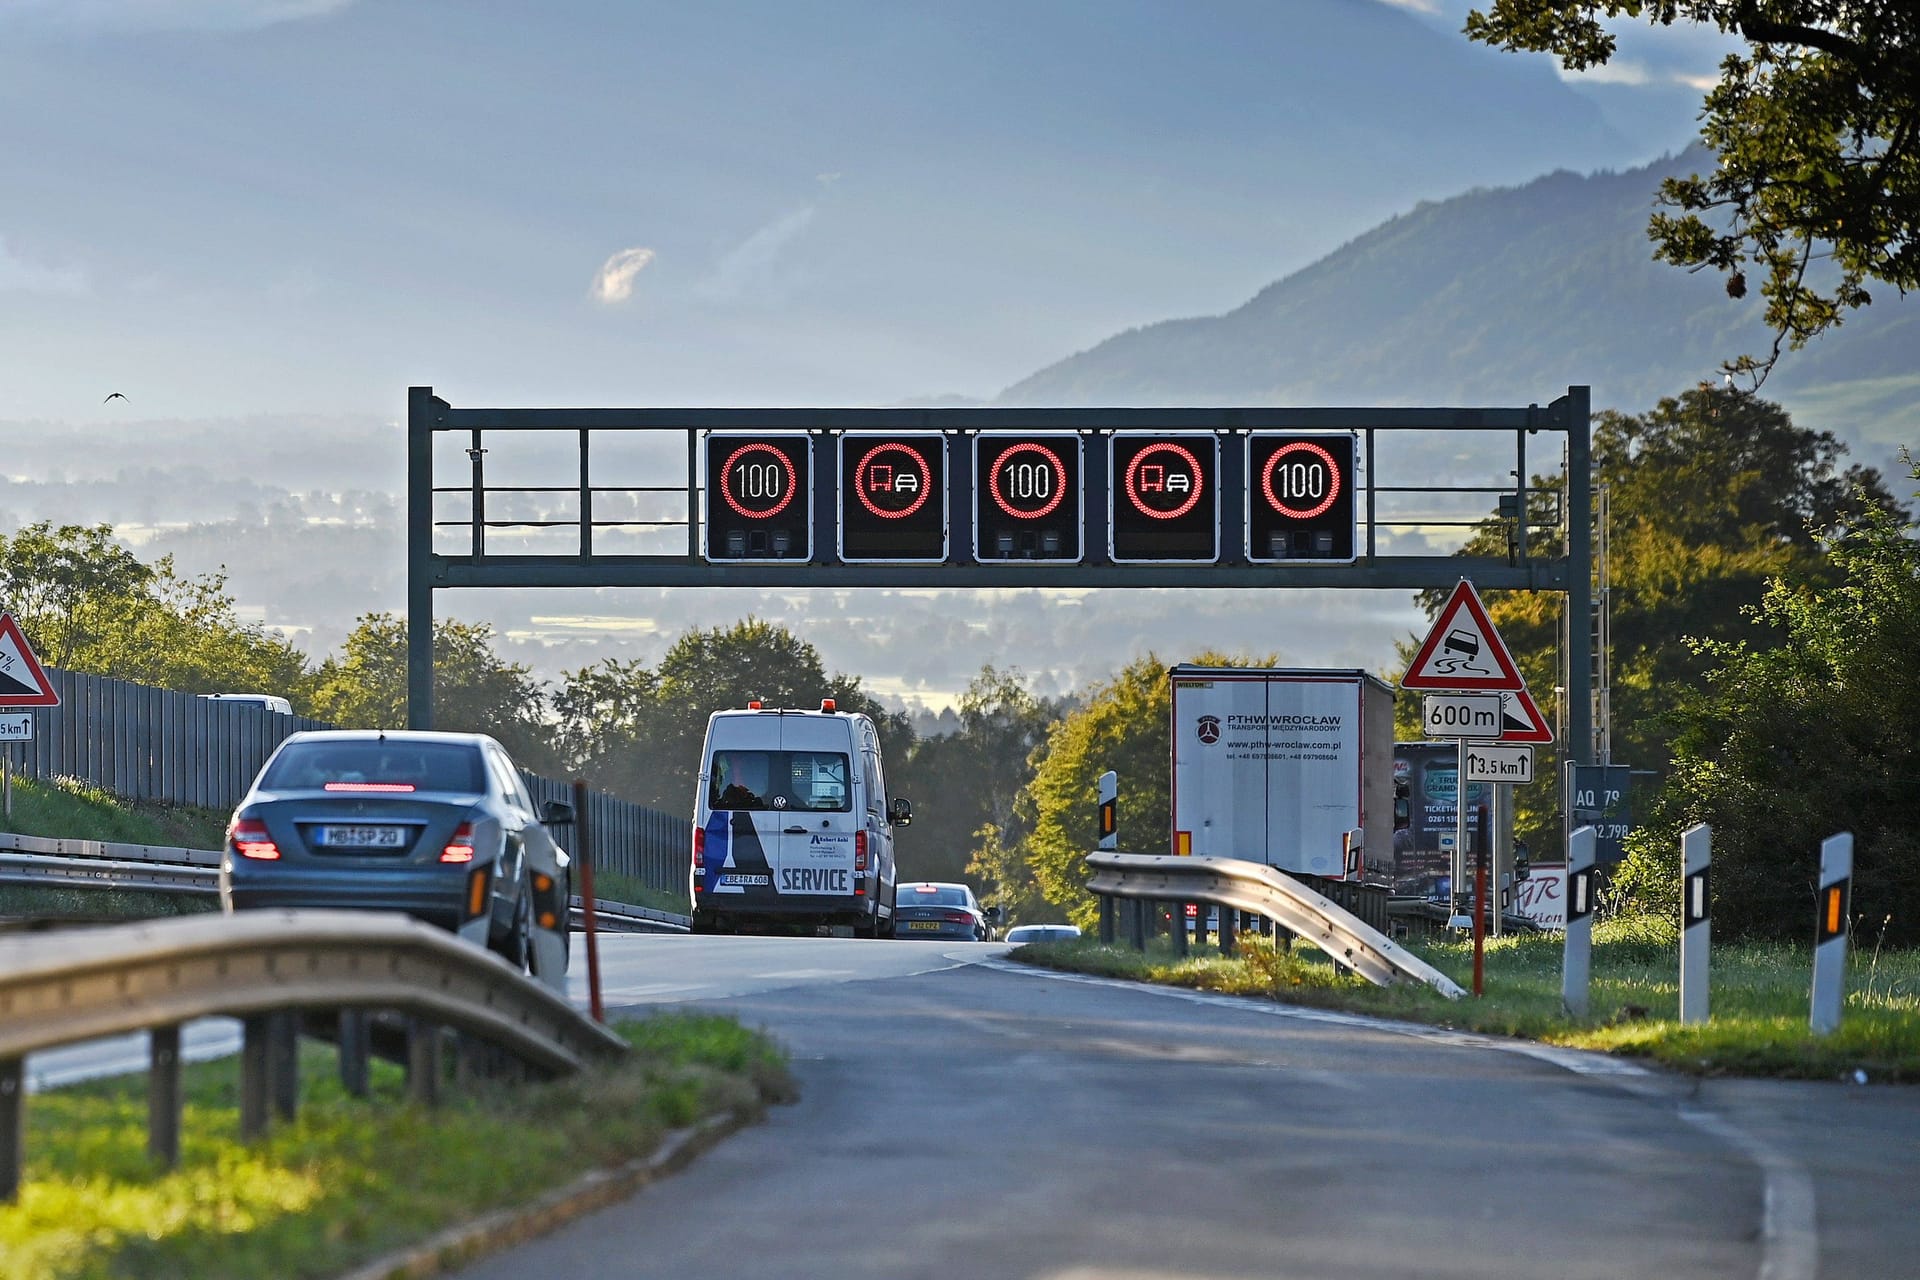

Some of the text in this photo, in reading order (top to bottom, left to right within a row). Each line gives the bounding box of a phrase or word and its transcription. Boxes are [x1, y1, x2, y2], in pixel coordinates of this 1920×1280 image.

[735, 464, 779, 498] 100
[1005, 464, 1049, 498] 100
[1278, 463, 1322, 498] 100
[1227, 715, 1267, 724] PTHW
[1270, 715, 1341, 725] WROCŁAW
[1431, 705, 1495, 726] 600 m
[7, 723, 22, 735] km
[1227, 741, 1342, 750] www.pthw-wroclaw.com.pl
[1477, 757, 1518, 775] 3,5 km
[1576, 790, 1595, 806] AQ
[782, 868, 848, 891] SERVICE
